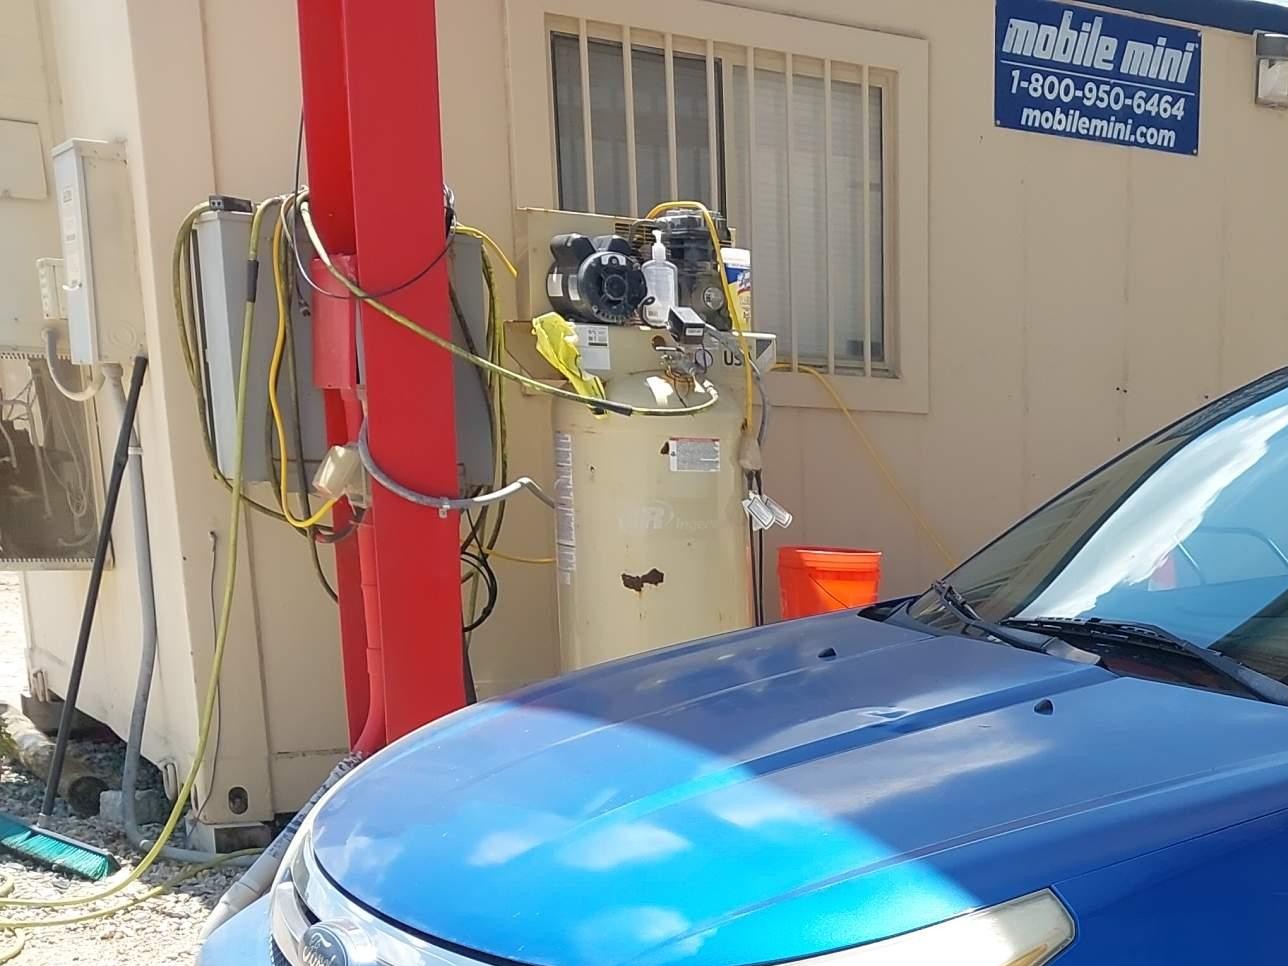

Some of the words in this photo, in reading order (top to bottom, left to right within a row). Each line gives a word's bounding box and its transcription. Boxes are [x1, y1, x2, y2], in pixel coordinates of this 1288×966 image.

[1002, 10, 1118, 71] mobile
[1119, 37, 1195, 84] mini
[1010, 69, 1186, 121] 1-800-950-6464
[1021, 107, 1176, 147] mobilemini.com
